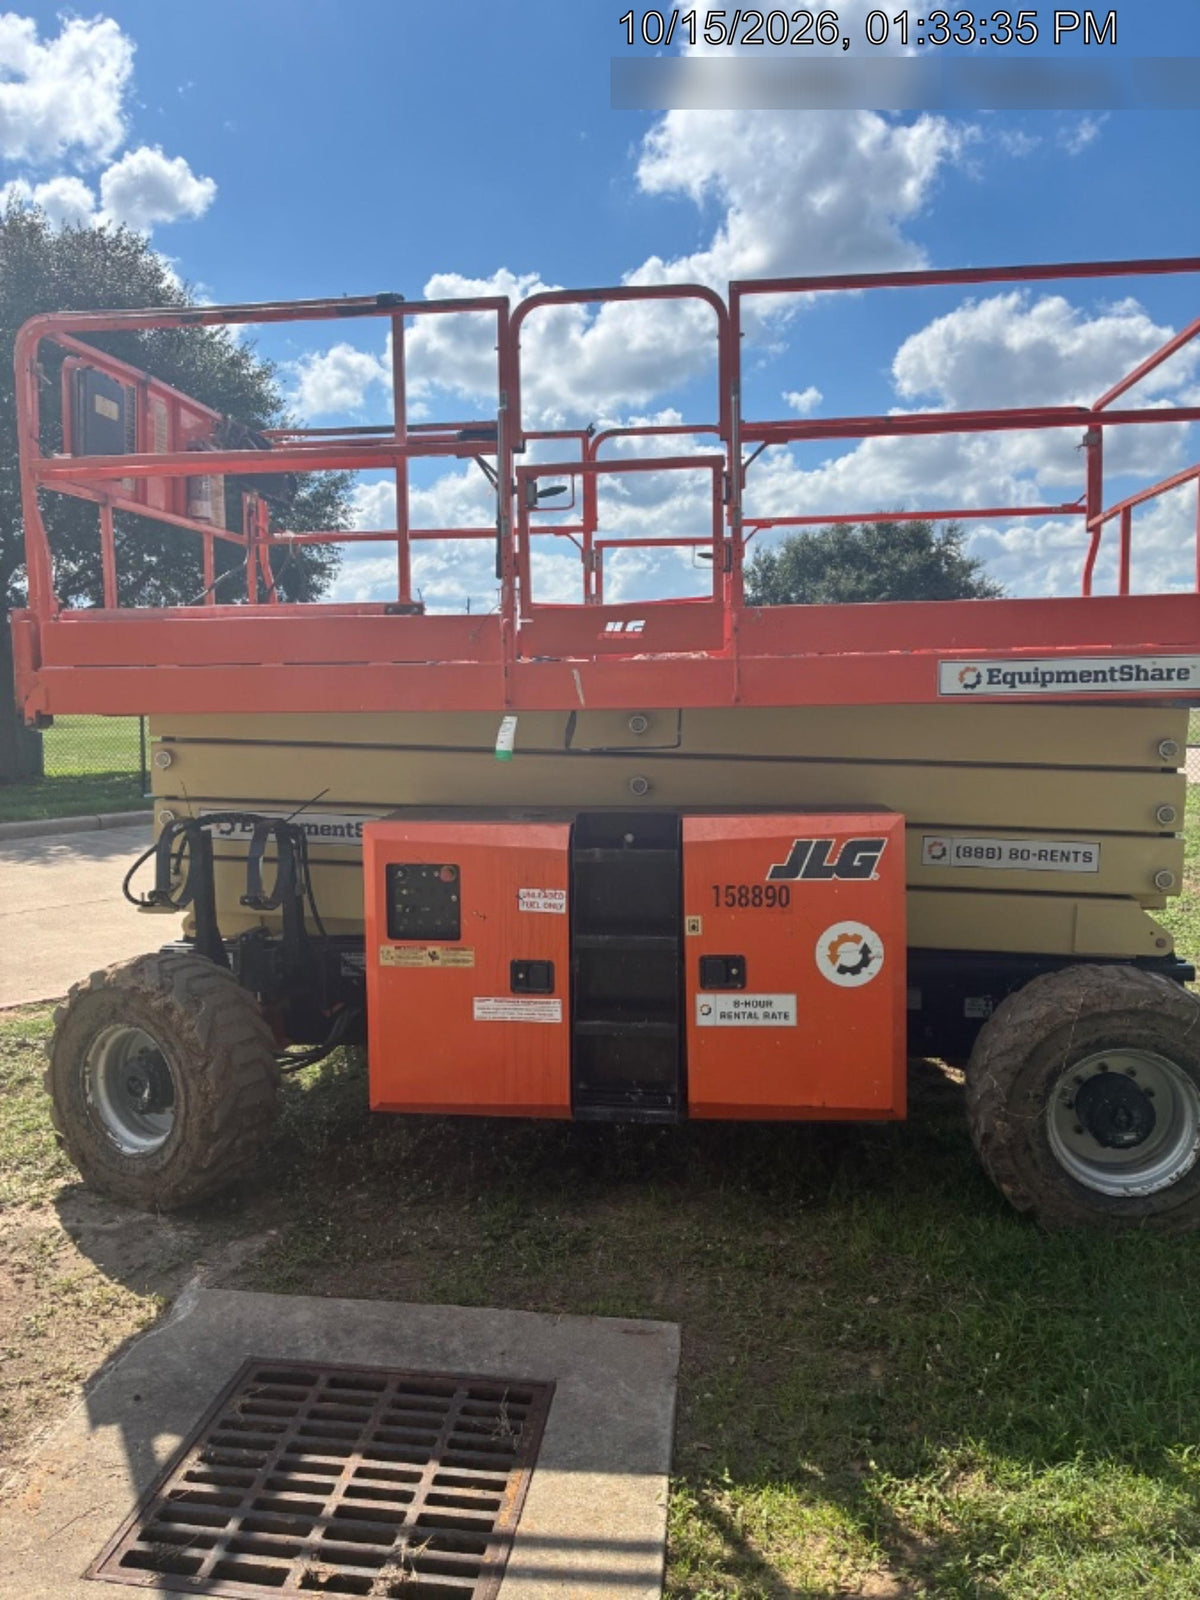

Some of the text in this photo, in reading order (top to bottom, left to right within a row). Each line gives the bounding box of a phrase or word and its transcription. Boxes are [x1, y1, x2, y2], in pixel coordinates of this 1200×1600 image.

[986, 664, 1191, 688] EquipmentShare
[766, 838, 888, 881] JLG
[956, 845, 1093, 864] (888) 80-RENTS
[712, 884, 790, 908] 158890
[521, 901, 564, 911] FUEL ONLY
[733, 1000, 773, 1009] 8-HOUR
[719, 1011, 790, 1020] RENTAL RATE
